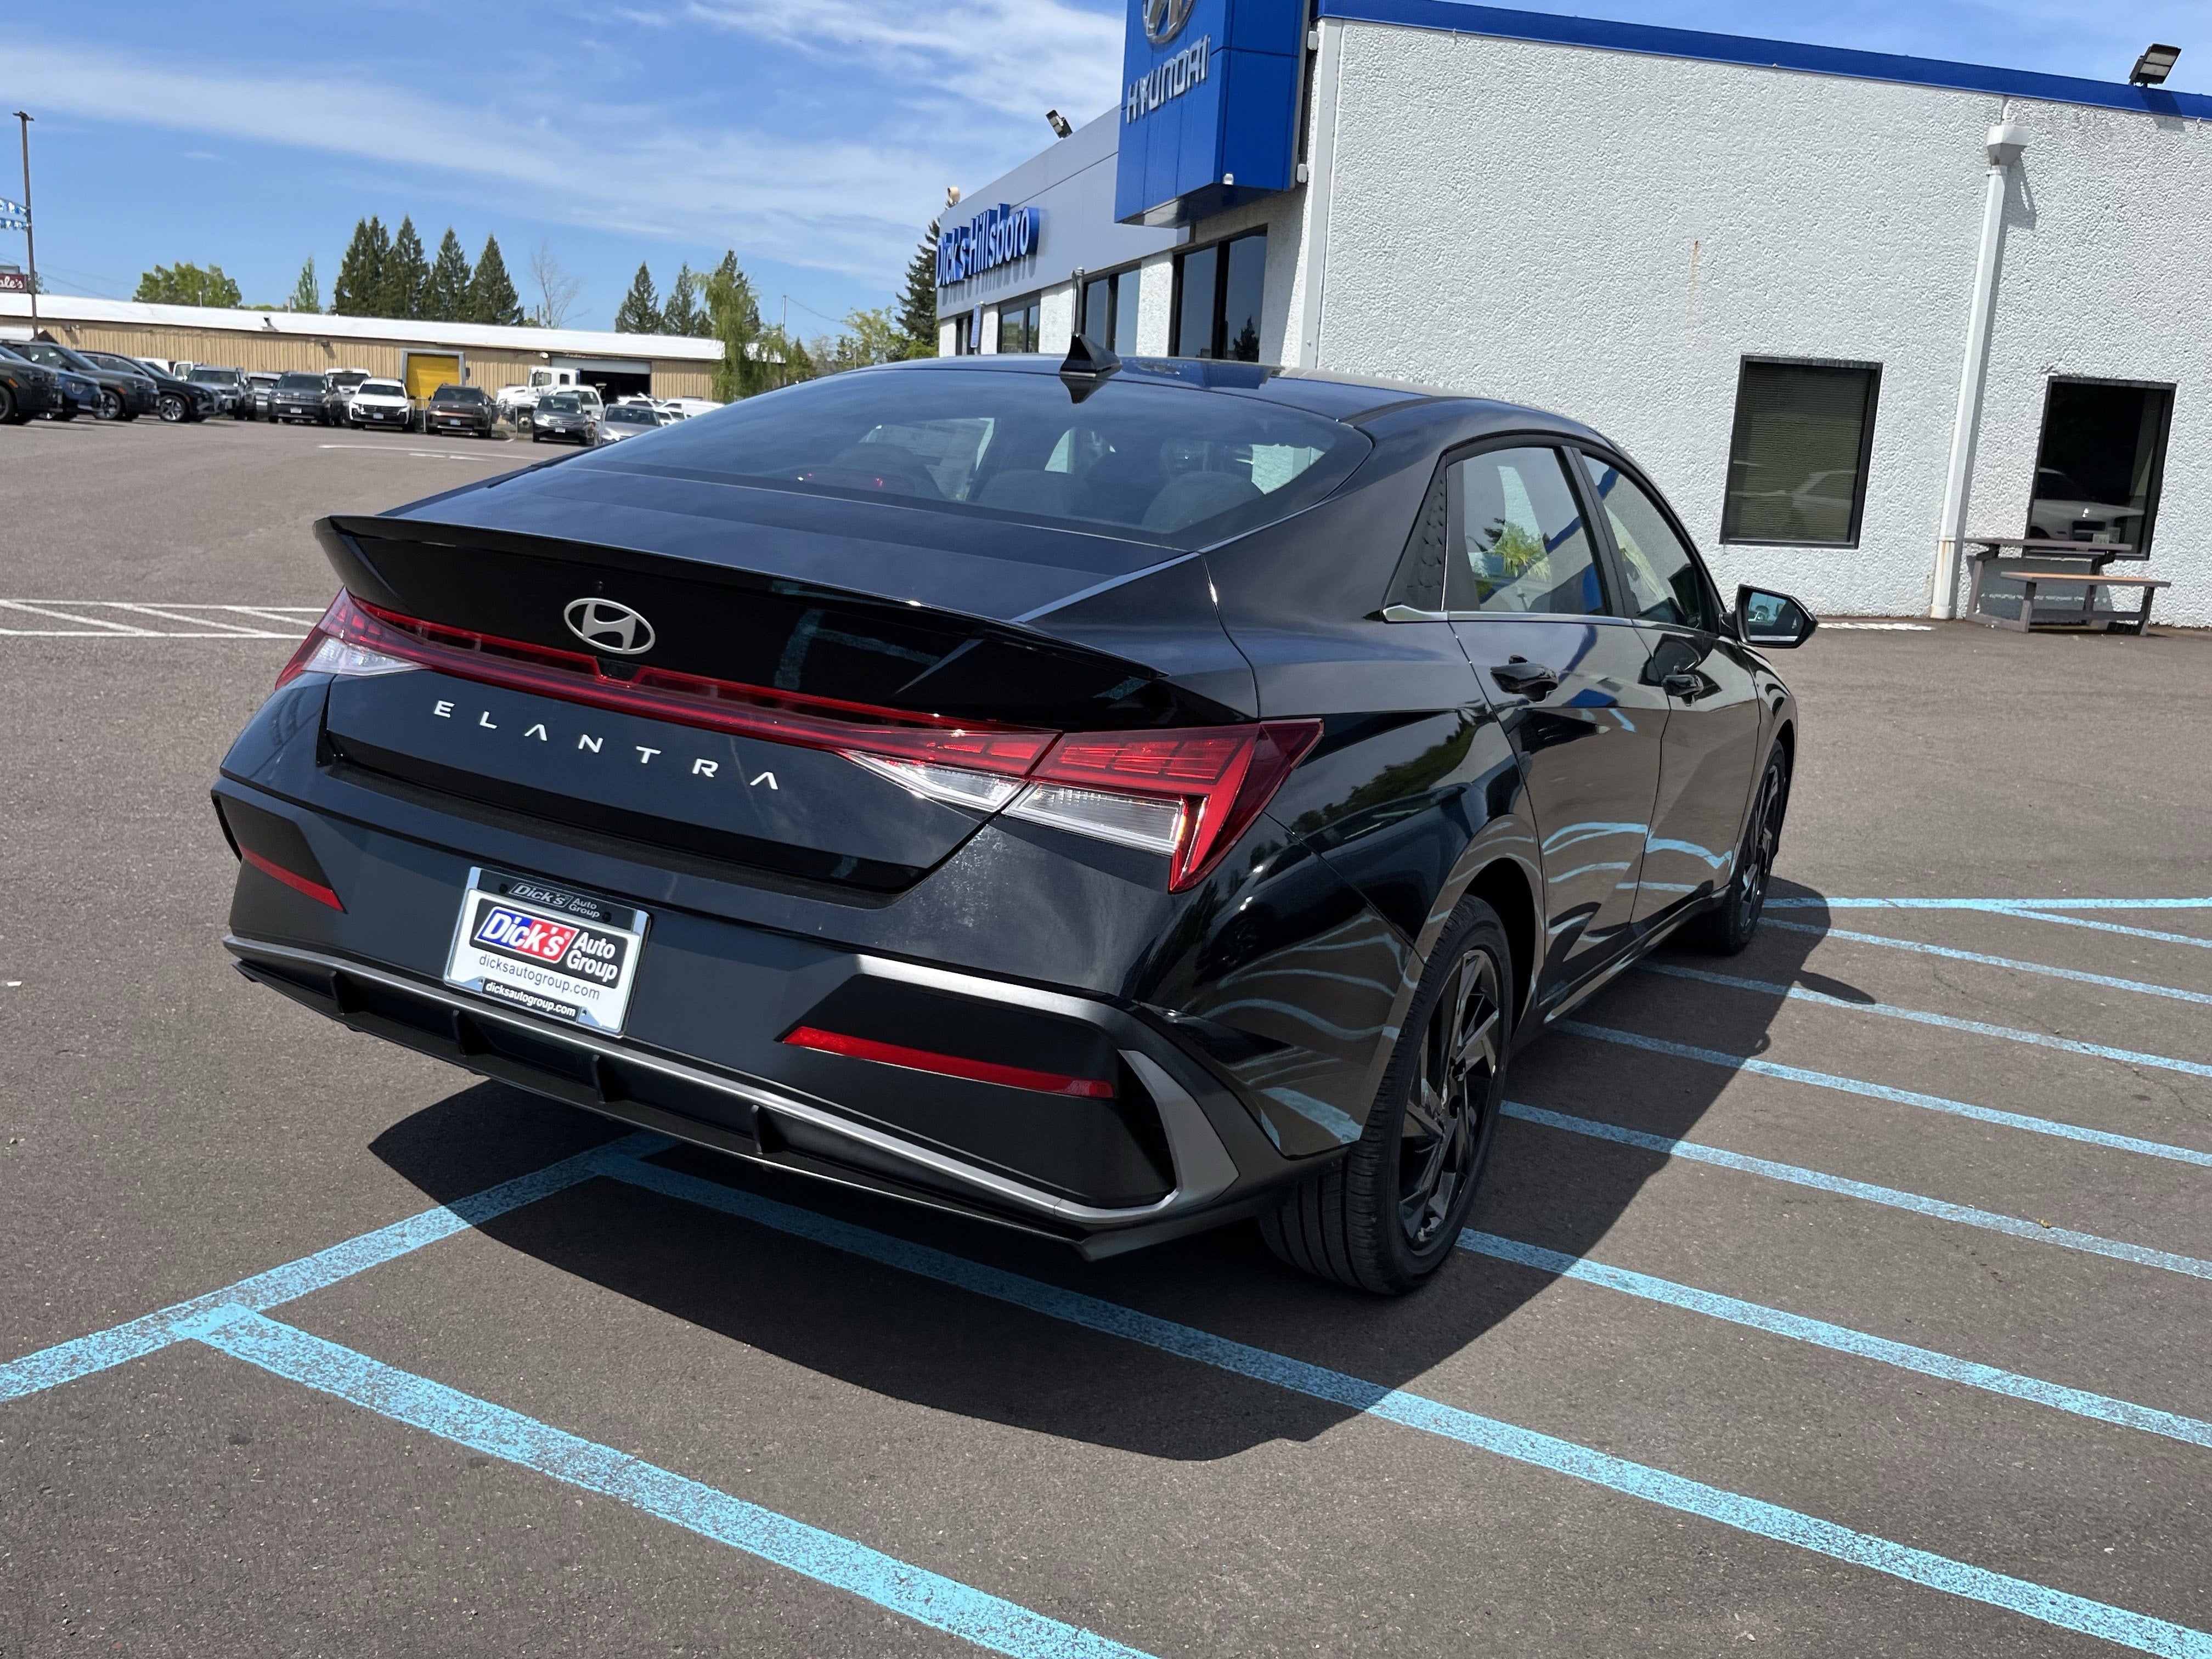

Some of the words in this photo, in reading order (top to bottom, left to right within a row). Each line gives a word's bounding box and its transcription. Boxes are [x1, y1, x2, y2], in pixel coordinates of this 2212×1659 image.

[1126, 35, 1210, 123] HYUNDAI
[935, 225, 969, 288] Dick's
[968, 204, 1033, 275] Hillsboro
[434, 700, 778, 790] ELANTRA
[514, 886, 567, 906] Dick's
[568, 904, 600, 918] Group
[572, 898, 597, 910] Auto
[483, 912, 566, 957] Dick's
[573, 932, 616, 959] Auto
[479, 954, 600, 1000] dicksautogroup.com
[566, 949, 618, 983] Group
[486, 981, 576, 1017] dicksautogroup.com
